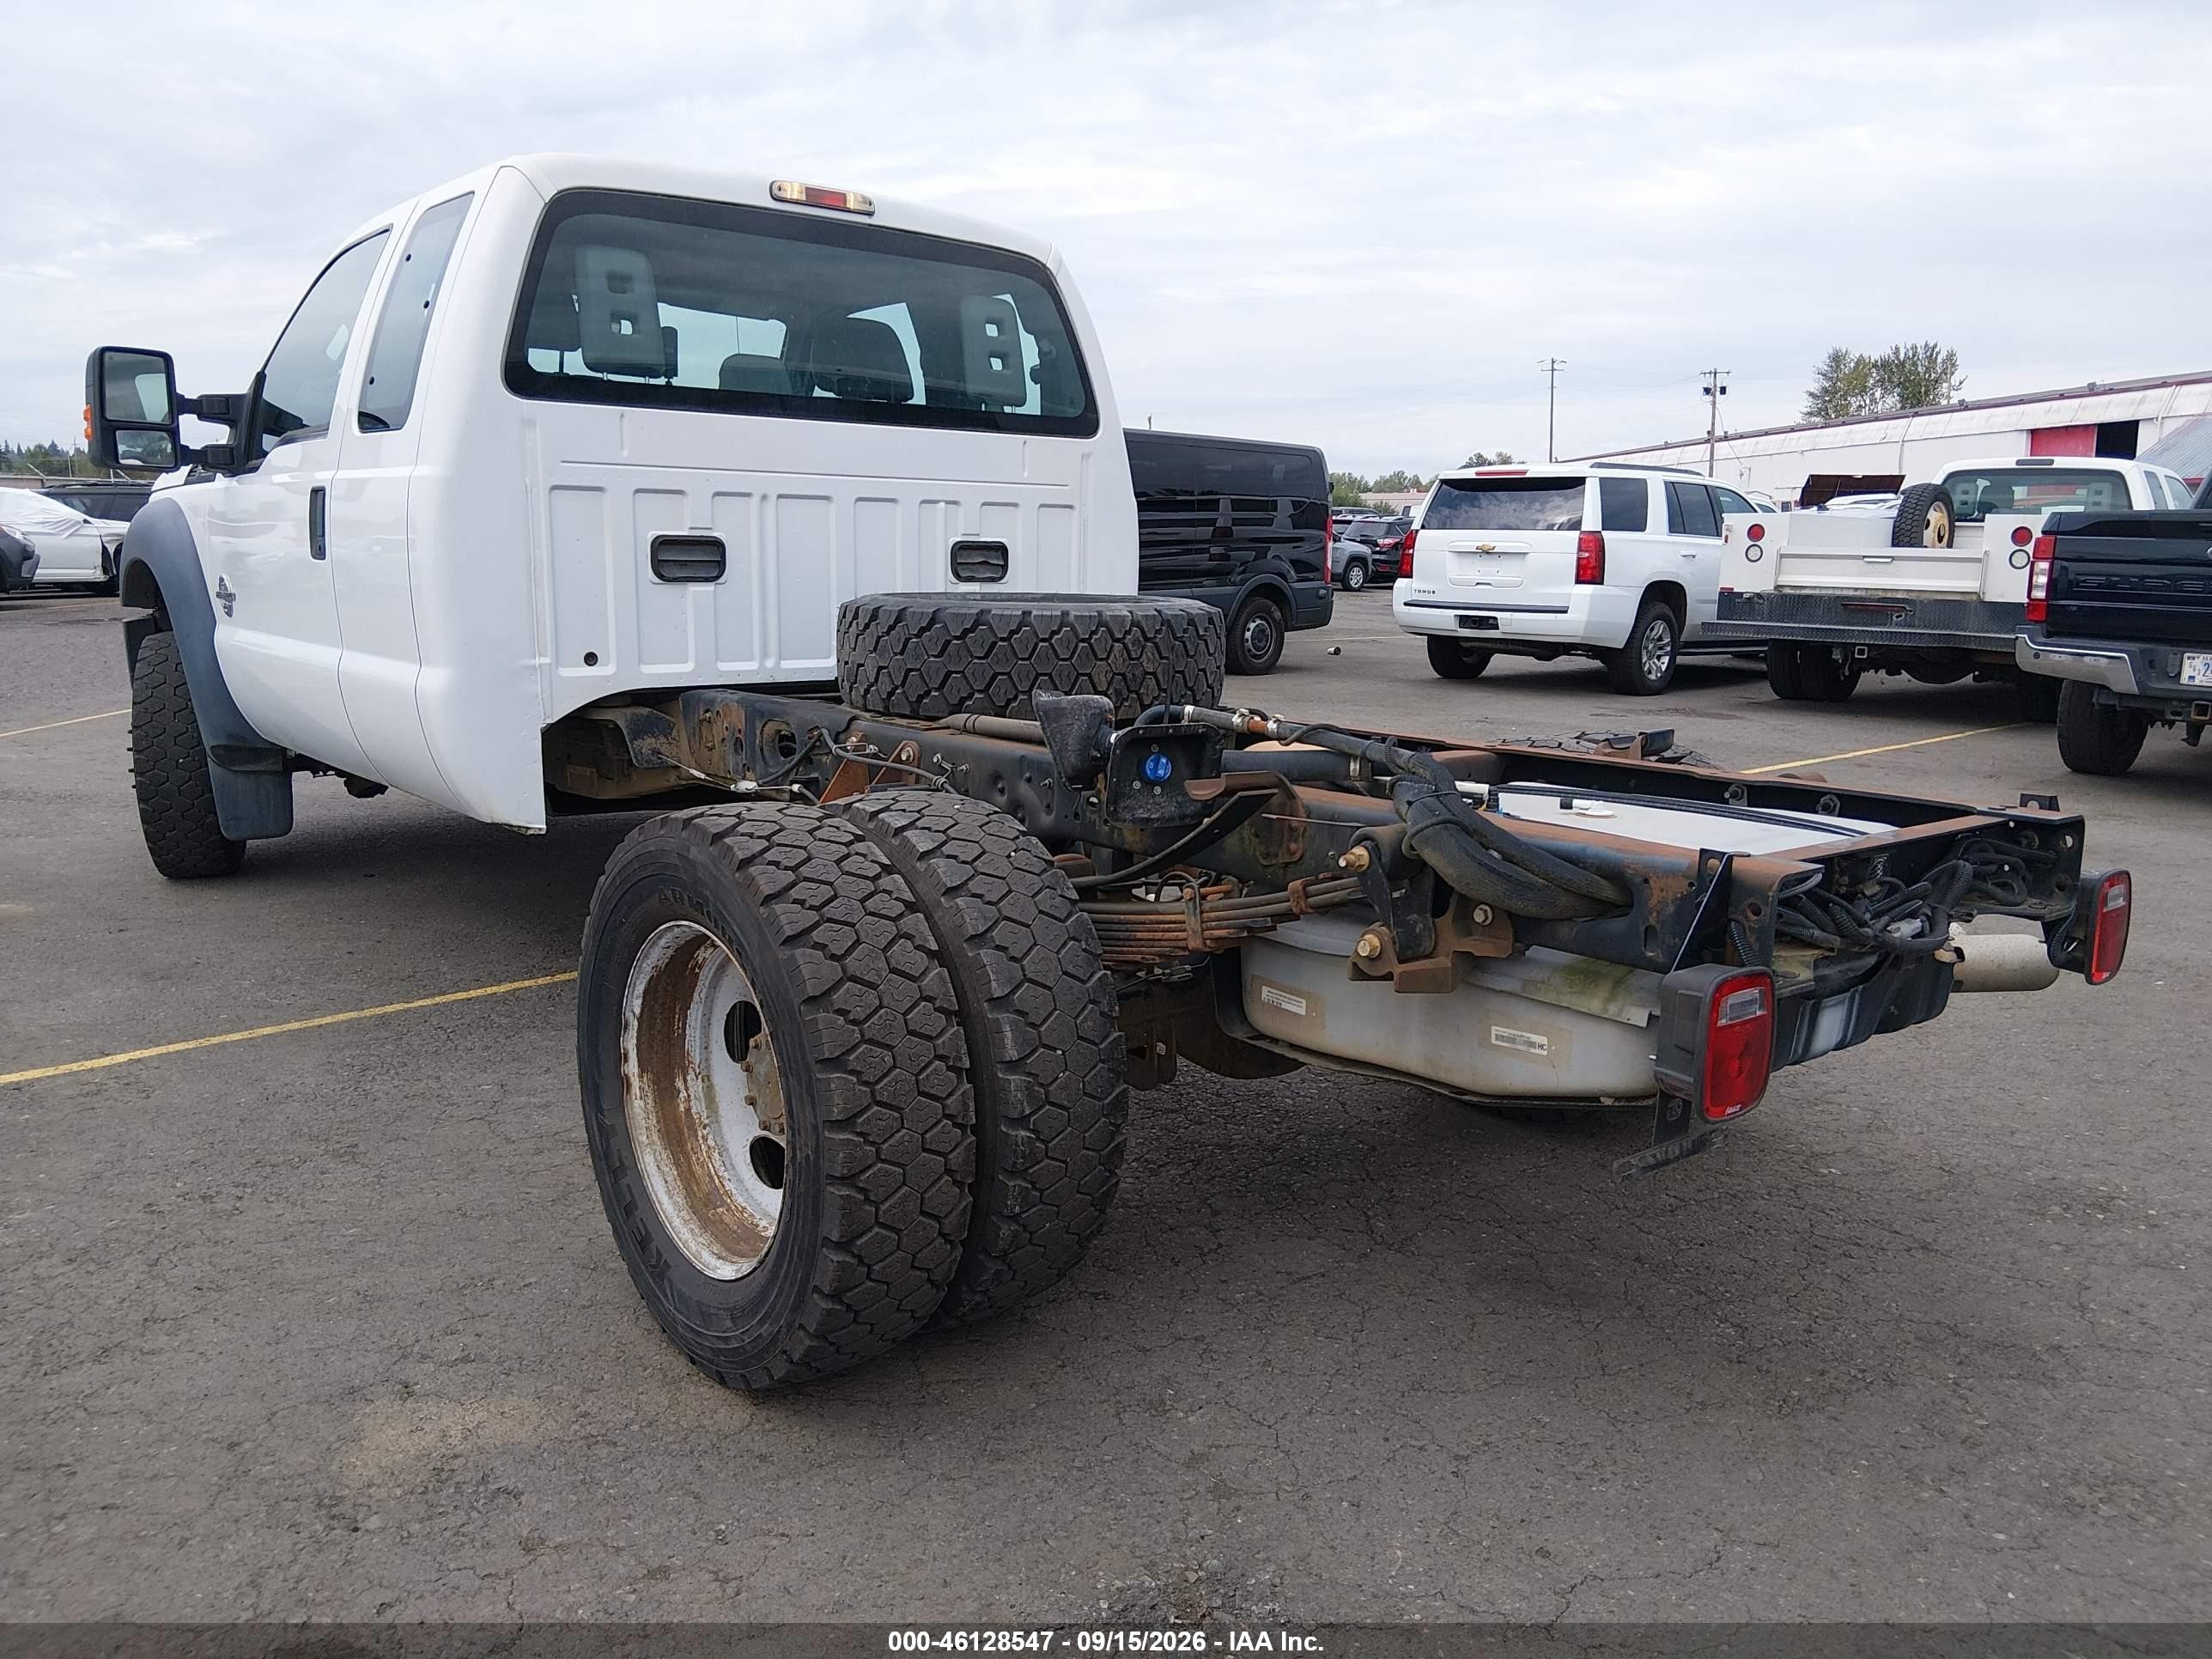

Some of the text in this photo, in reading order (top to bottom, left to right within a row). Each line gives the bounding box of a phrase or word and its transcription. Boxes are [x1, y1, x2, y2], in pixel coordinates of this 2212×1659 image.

[2077, 575, 2212, 592] SUPE
[1537, 1042, 1547, 1051] HC
[597, 1111, 672, 1286] KELLY
